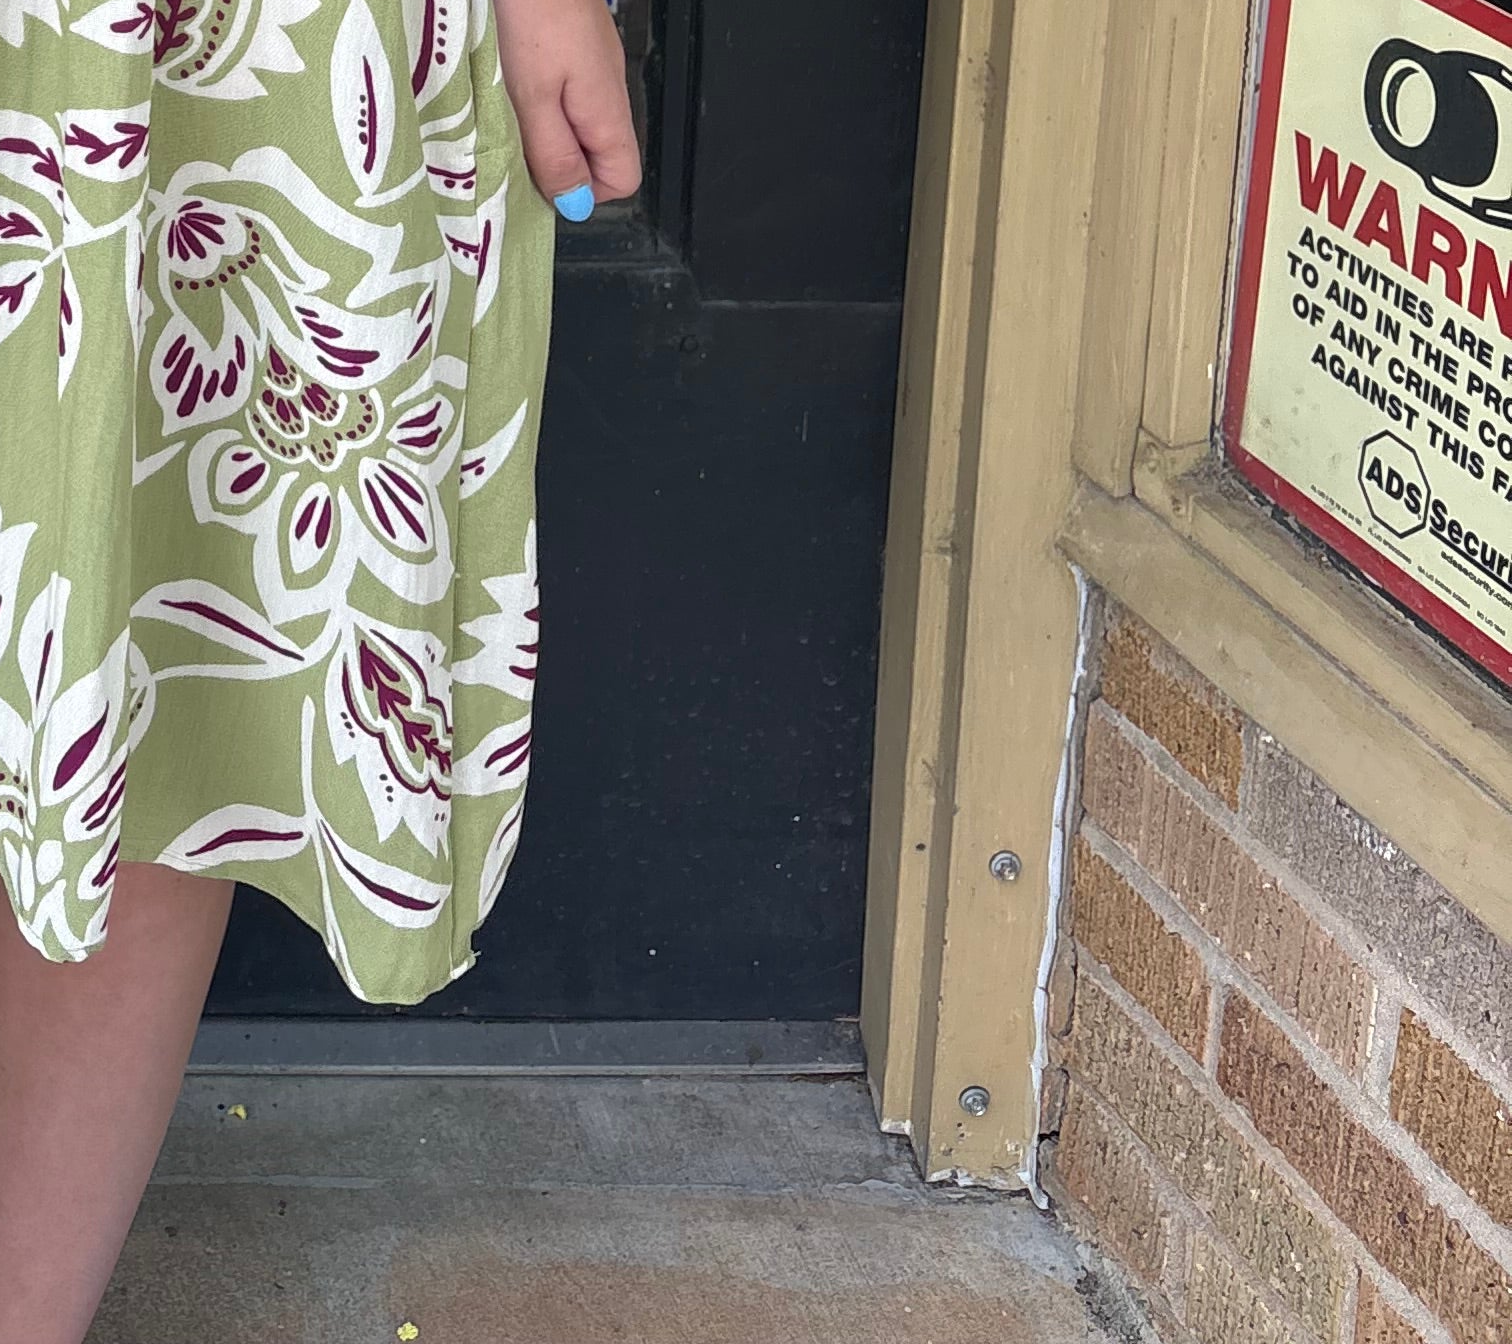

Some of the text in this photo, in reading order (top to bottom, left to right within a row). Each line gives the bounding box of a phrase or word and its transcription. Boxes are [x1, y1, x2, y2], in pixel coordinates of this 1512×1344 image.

[1294, 129, 1512, 340] WARN
[1299, 226, 1494, 371] ACTIVITIES ARE
[1287, 250, 1319, 289] TO
[1325, 279, 1368, 321] AID
[1375, 308, 1401, 346] IN
[1409, 330, 1459, 385] THE
[1292, 293, 1325, 327] OF
[1330, 319, 1382, 367] ANY
[1388, 357, 1470, 432] CRIME
[1310, 344, 1420, 431] AGAINST
[1427, 419, 1485, 480] THIS
[1365, 456, 1423, 515] ADS
